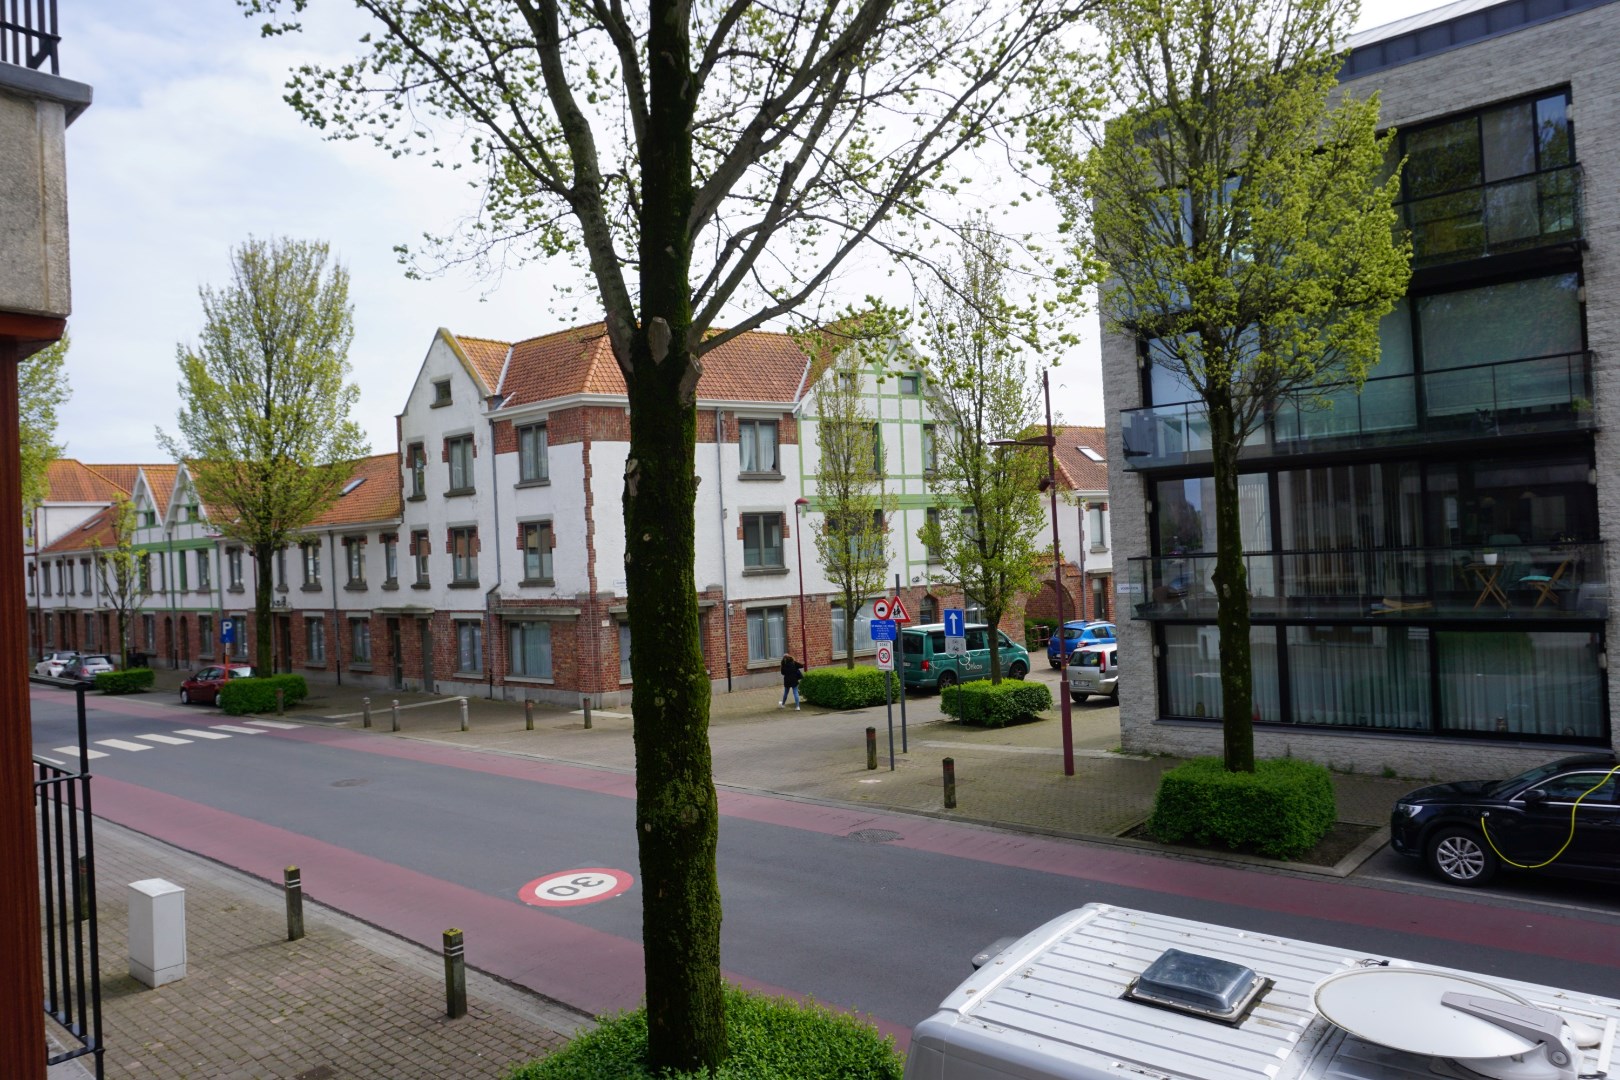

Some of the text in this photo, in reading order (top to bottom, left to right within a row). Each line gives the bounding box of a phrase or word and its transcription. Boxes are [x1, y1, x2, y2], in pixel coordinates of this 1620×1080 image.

[222, 621, 232, 635] P
[880, 652, 888, 660] 30
[547, 876, 605, 897] 30
